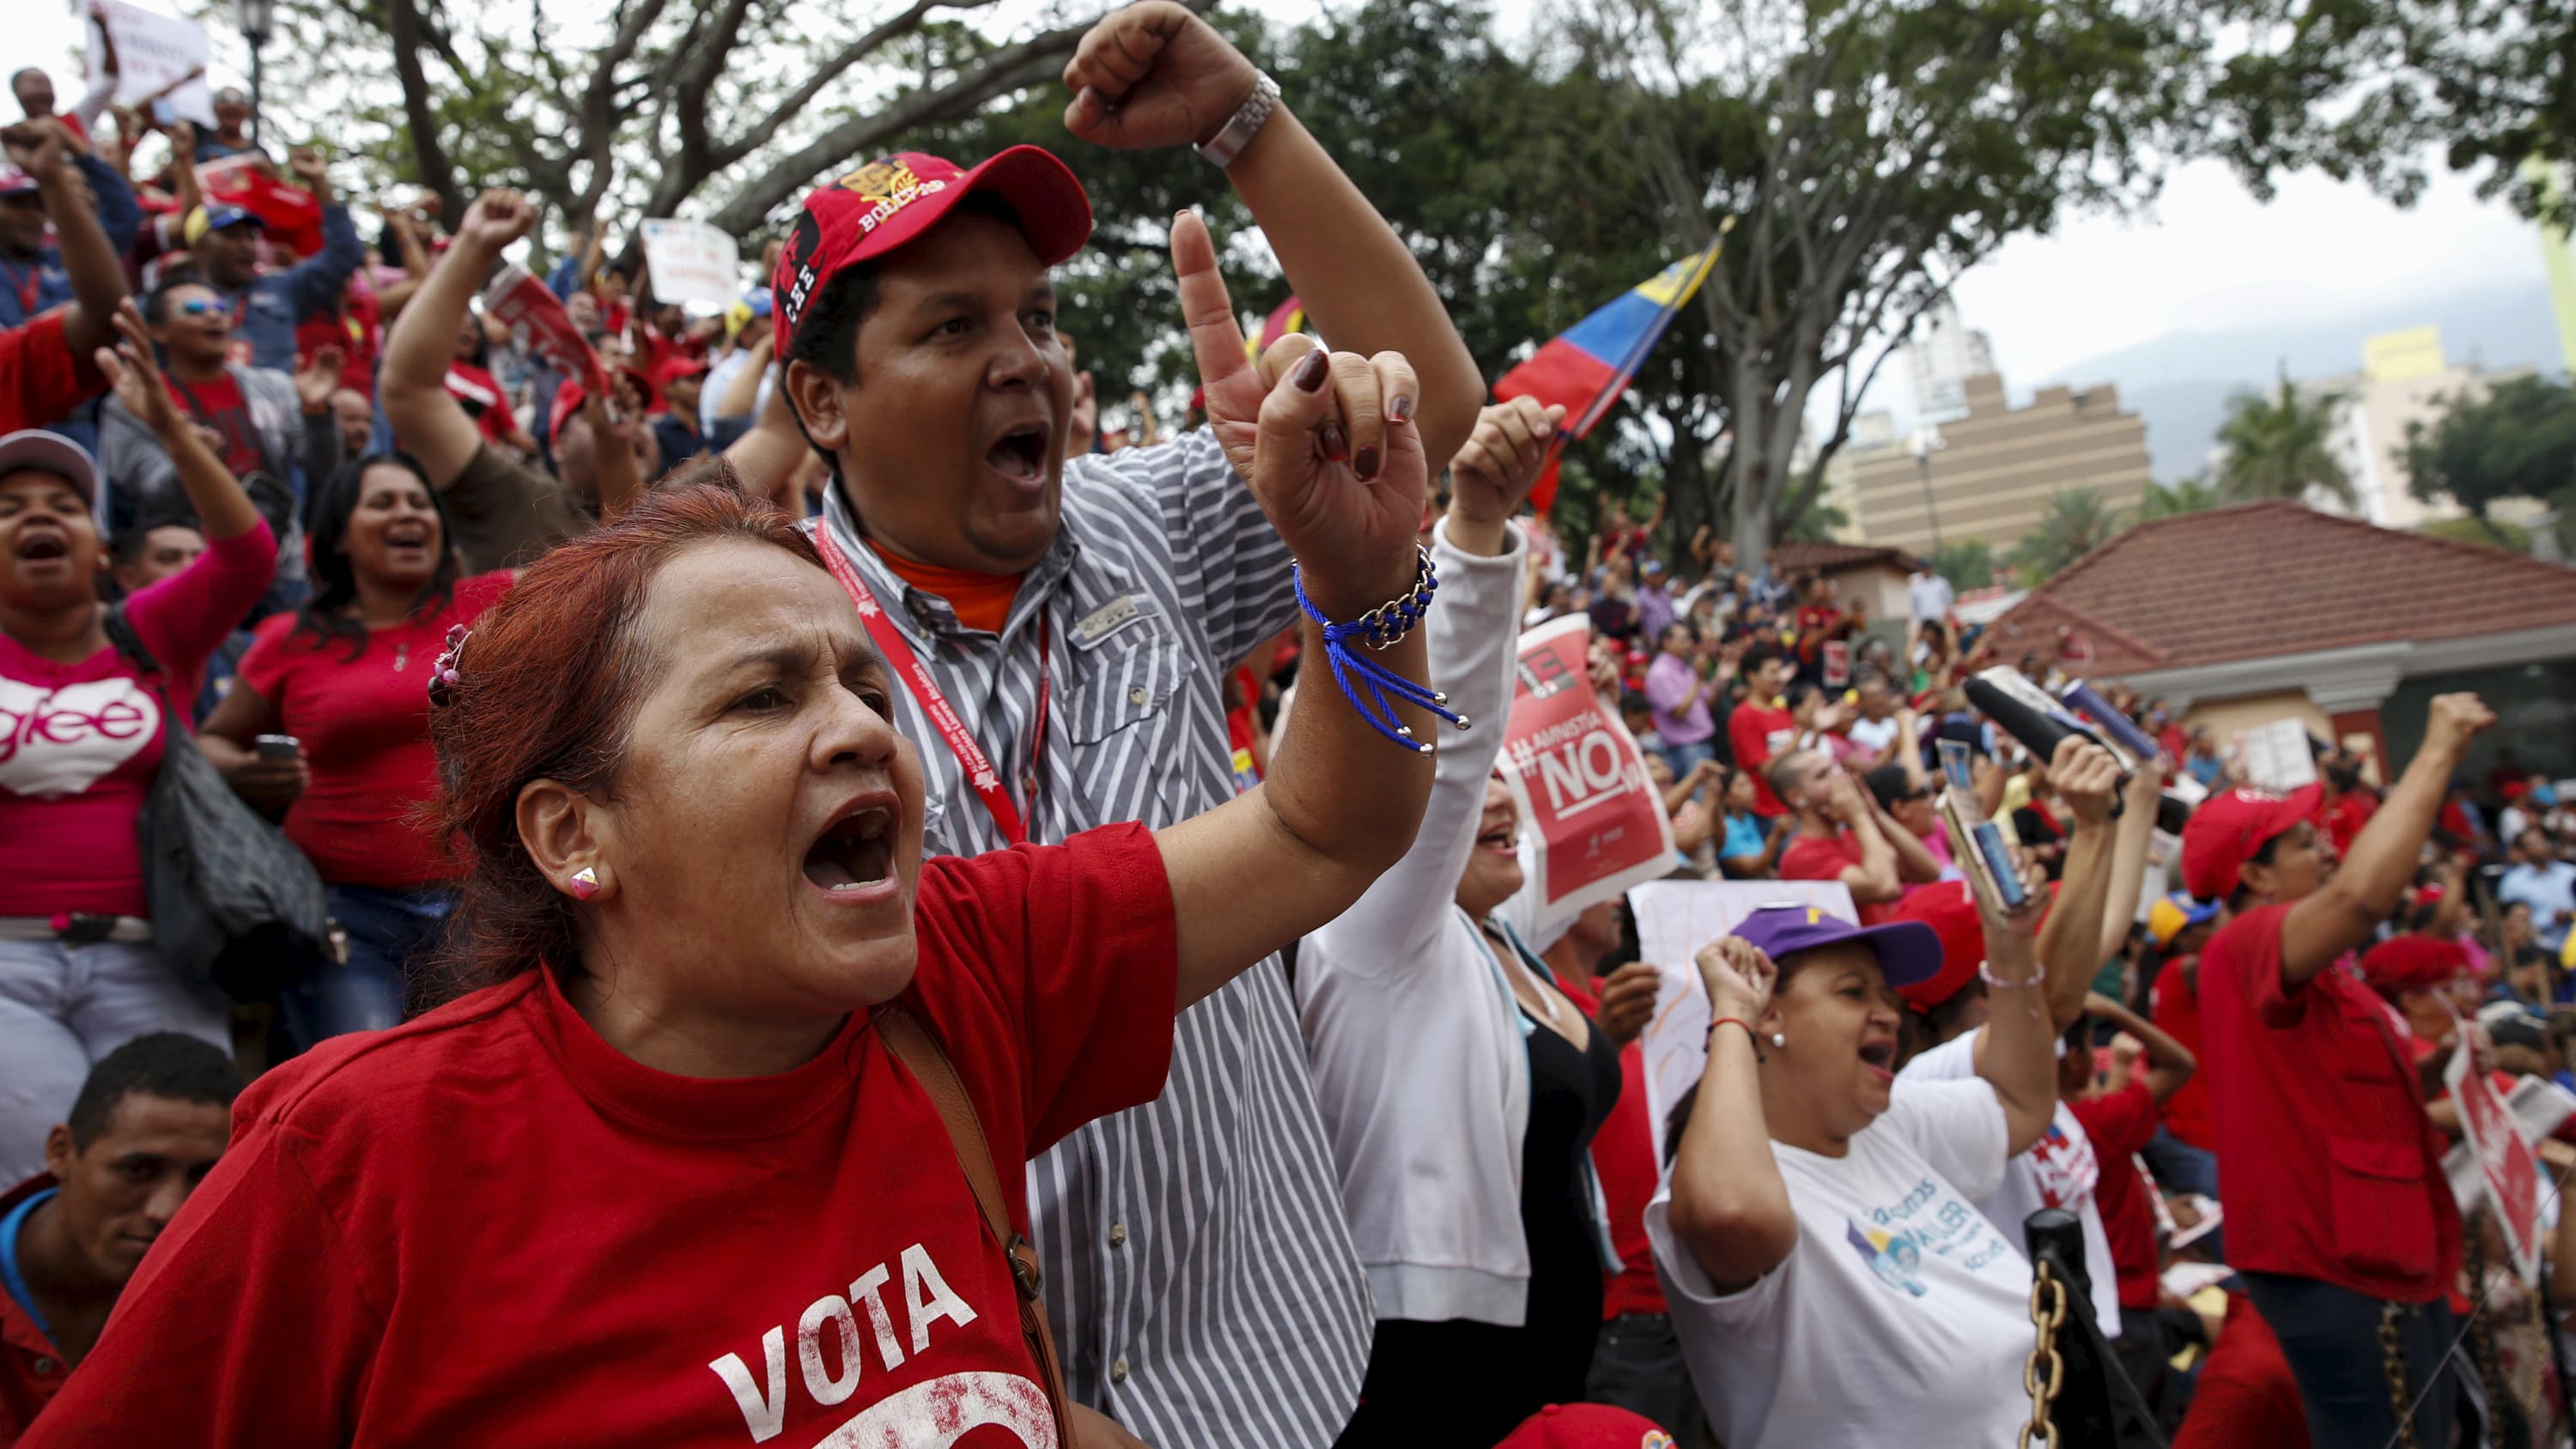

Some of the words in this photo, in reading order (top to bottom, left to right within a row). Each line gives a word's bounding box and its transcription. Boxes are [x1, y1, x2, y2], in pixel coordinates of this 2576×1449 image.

[785, 264, 816, 324] CHE
[937, 700, 963, 731] Linares
[957, 728, 989, 771] Francisco
[1539, 730, 1621, 810] NO
[708, 1242, 978, 1444] VOTA
